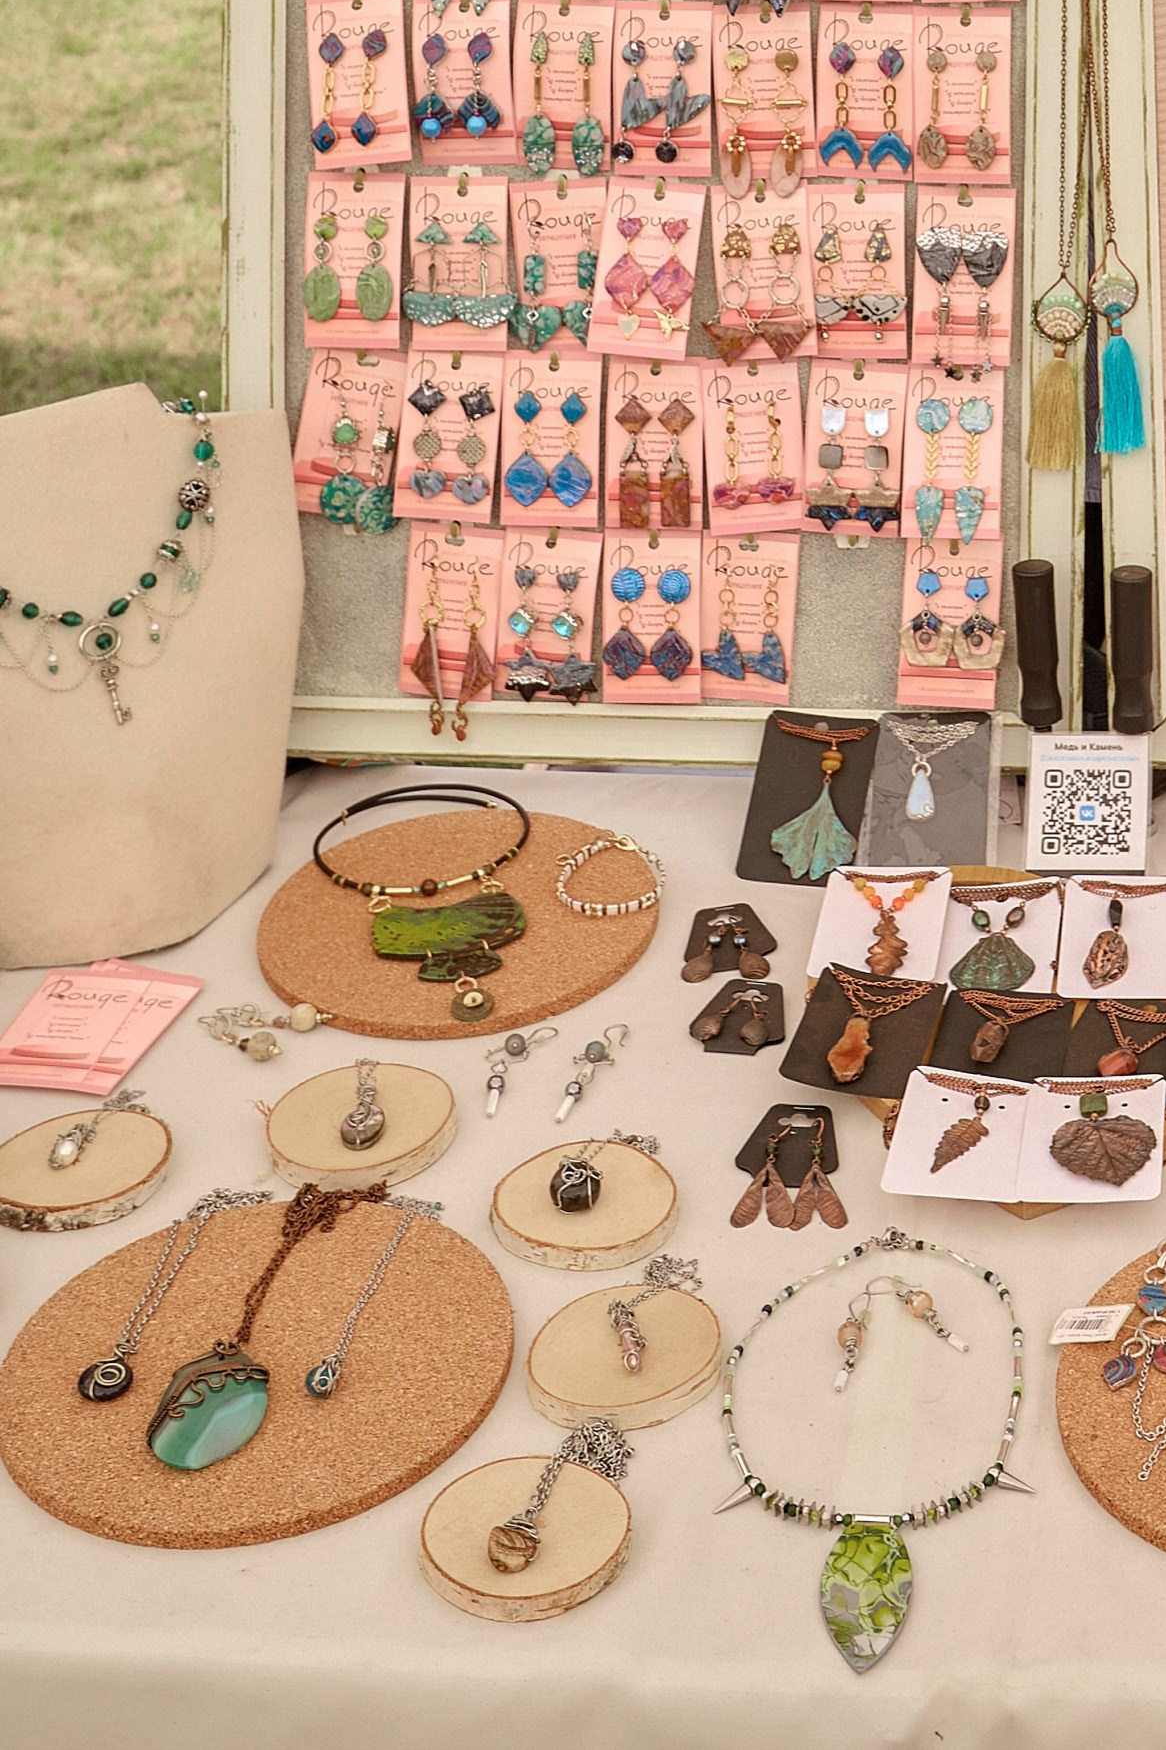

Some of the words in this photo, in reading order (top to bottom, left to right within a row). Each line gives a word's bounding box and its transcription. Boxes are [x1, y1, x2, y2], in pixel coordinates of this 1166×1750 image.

[611, 187, 691, 229] Rou
[912, 370, 994, 407] Roue
[1054, 743, 1079, 752] Медь
[1089, 742, 1123, 751] Камень
[42, 974, 129, 1009] Rouge
